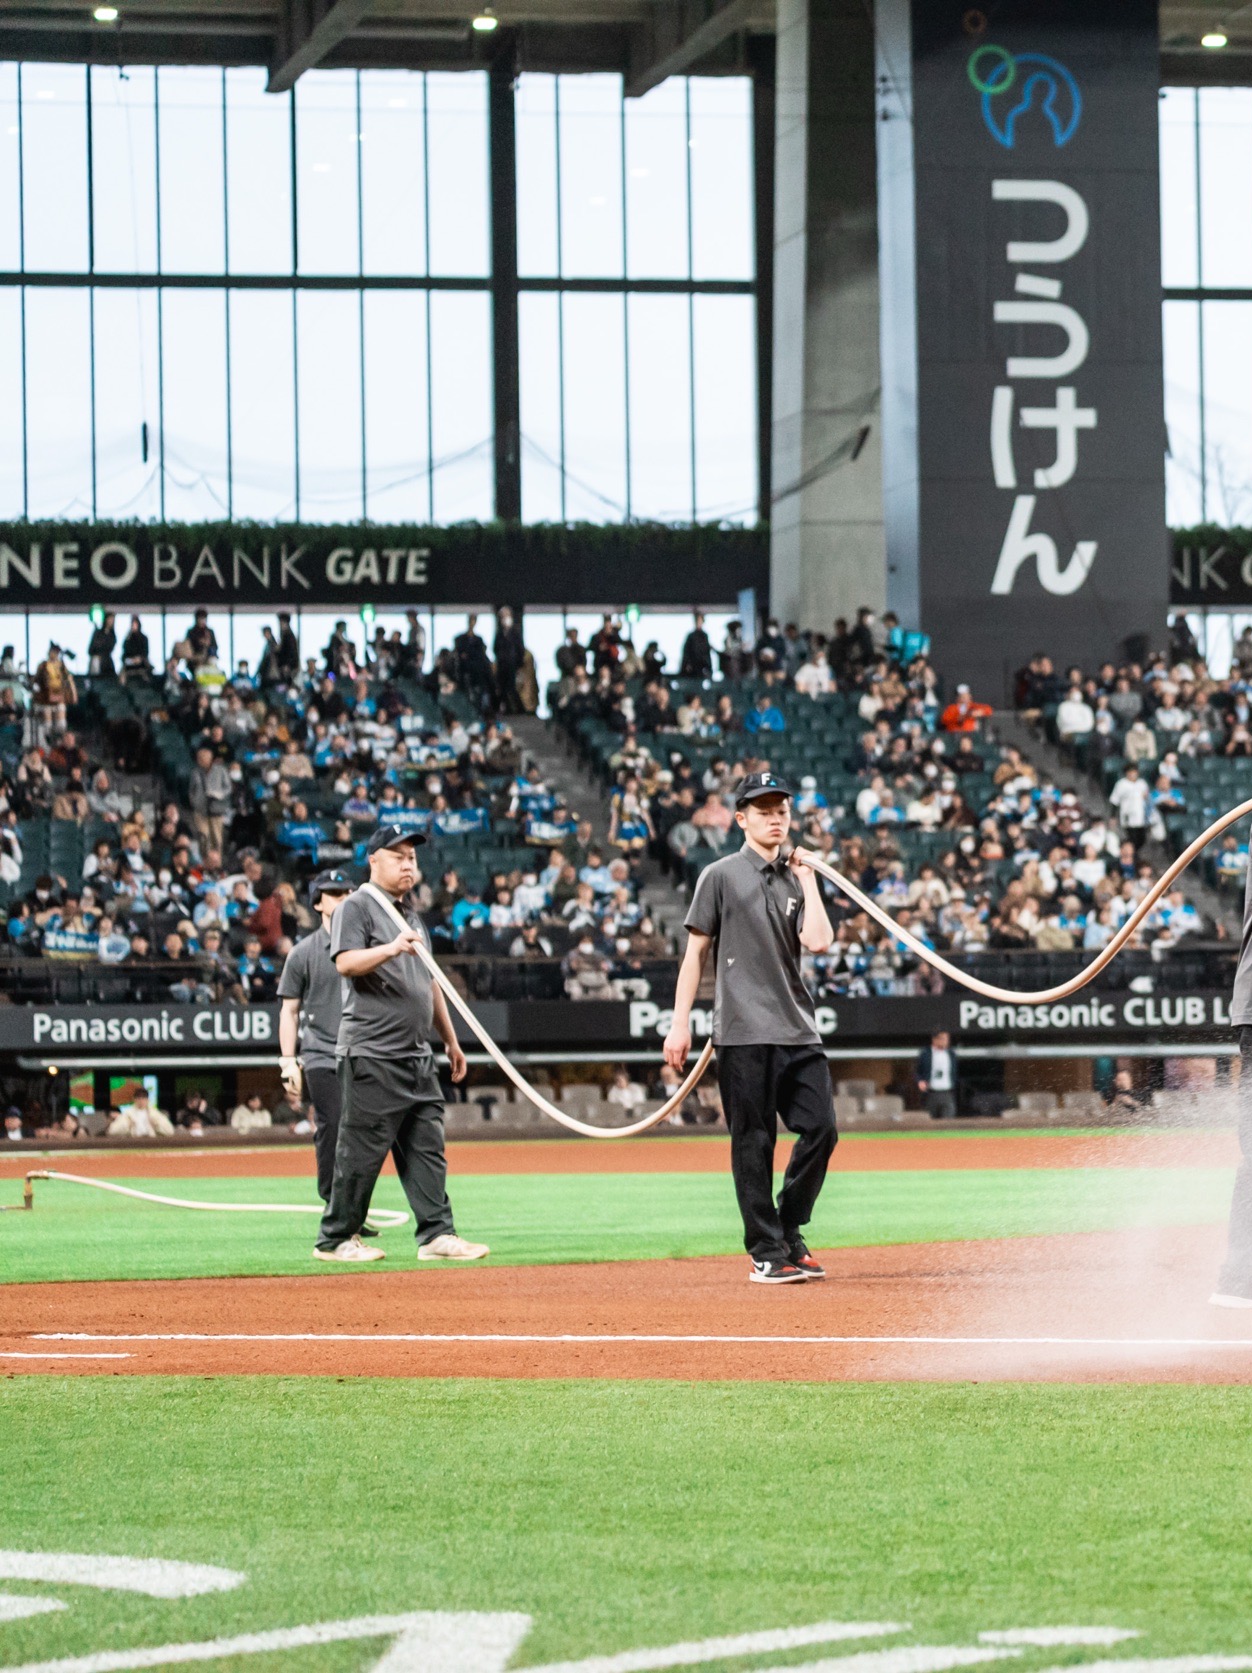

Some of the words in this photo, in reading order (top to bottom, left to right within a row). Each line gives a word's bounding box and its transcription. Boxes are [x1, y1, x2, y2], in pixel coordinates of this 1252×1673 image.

[990, 179, 1097, 595] つうけん
[325, 548, 430, 585] GATE
[785, 897, 797, 916] F
[33, 1010, 184, 1044] Panasonic
[192, 1011, 272, 1041] CLUB
[960, 998, 1116, 1030] Panasonic
[1123, 998, 1206, 1027] CLUB
